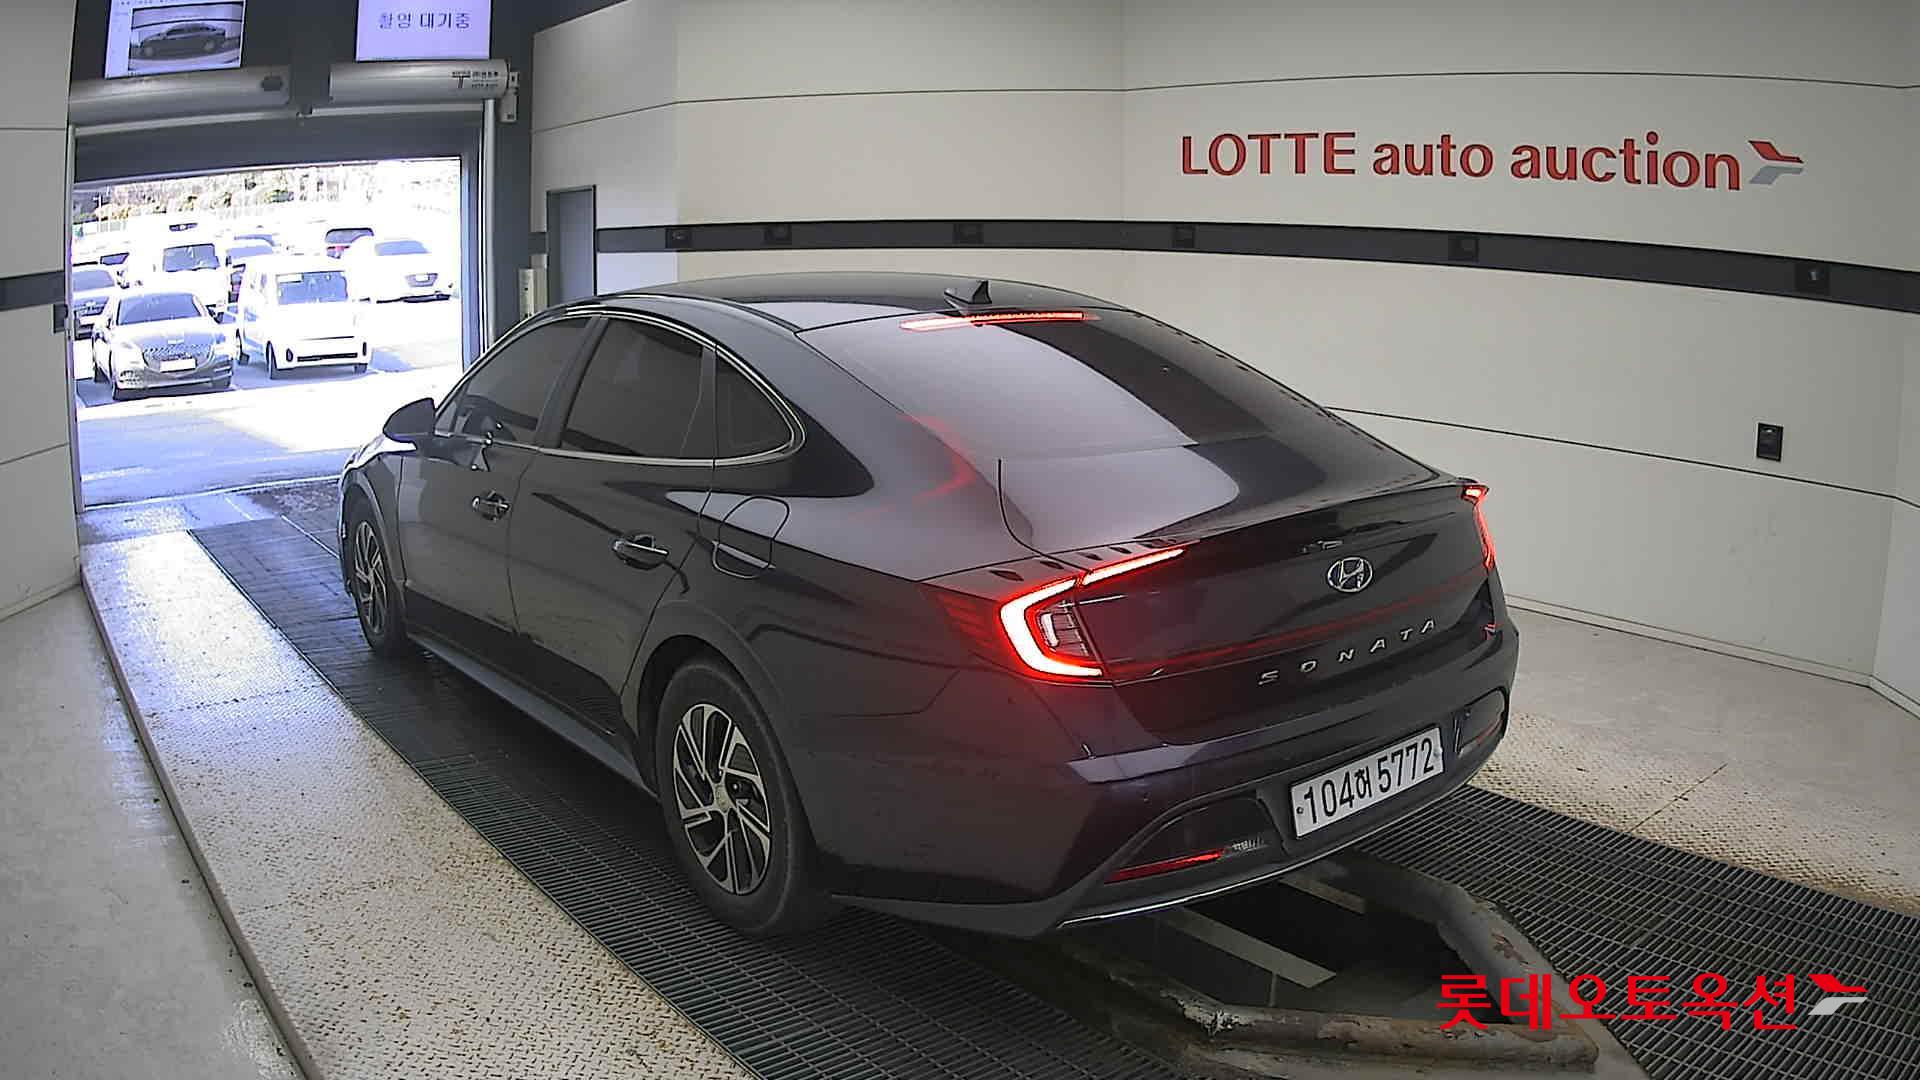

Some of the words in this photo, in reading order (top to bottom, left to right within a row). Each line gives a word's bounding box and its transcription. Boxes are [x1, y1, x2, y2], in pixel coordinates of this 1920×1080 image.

[420, 12, 470, 29] 대기중
[1181, 132, 1356, 176] LOTTE
[1372, 133, 1495, 177] auto
[1511, 130, 1741, 191] auction
[1257, 619, 1437, 685] SONATA
